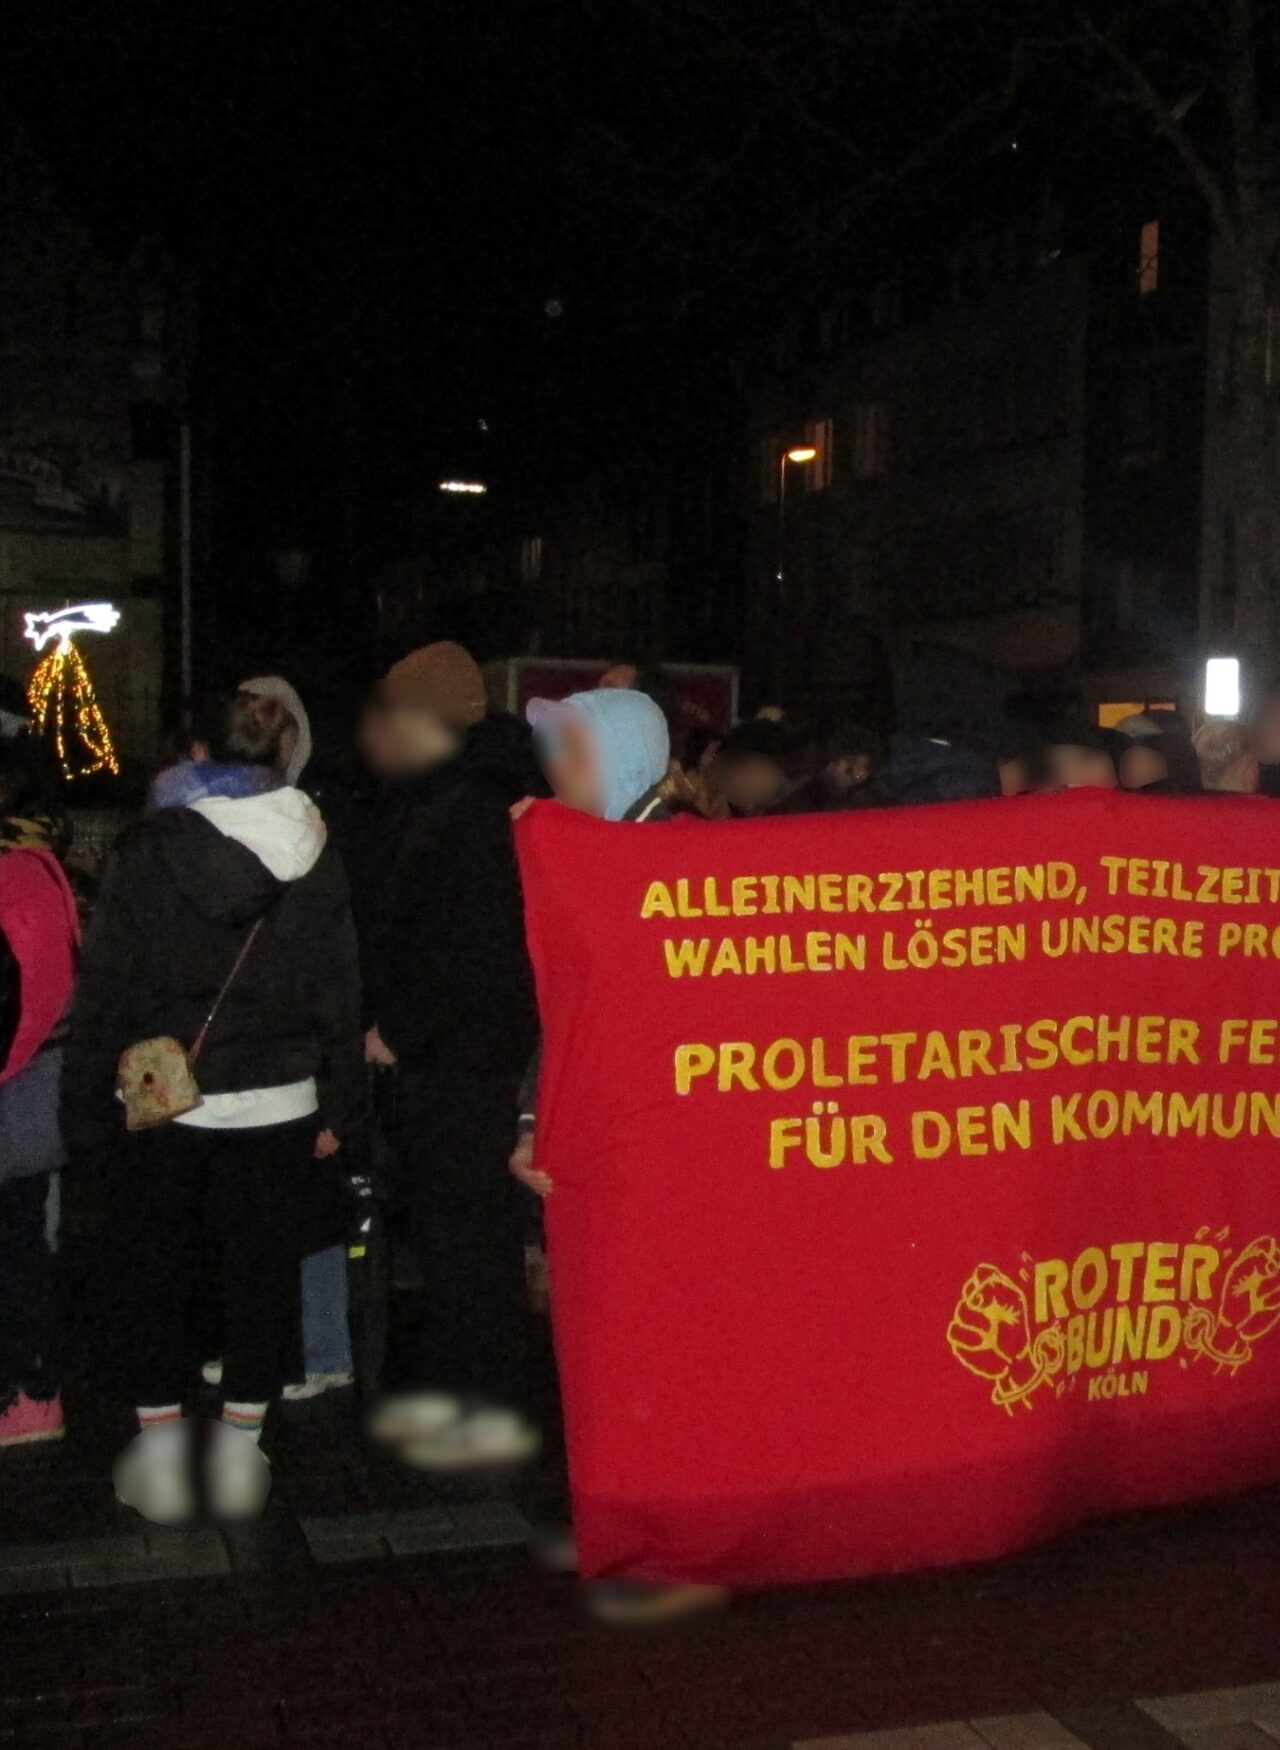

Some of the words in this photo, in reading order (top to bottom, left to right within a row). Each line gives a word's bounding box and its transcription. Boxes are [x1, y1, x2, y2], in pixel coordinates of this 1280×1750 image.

[640, 862, 1088, 920] ALLEINERZIEHEND,
[663, 931, 867, 979] WAHLEN
[883, 918, 1026, 971] LÖSEN
[1041, 914, 1205, 959] UNSERE
[673, 1014, 1200, 1096] PROLETARISCHER
[769, 1100, 894, 1169] FÜR
[912, 1098, 1032, 1159] DEN
[1035, 1241, 1220, 1324] ROTER
[1067, 1303, 1184, 1375] BUND
[1088, 1367, 1148, 1401] KÖLN
